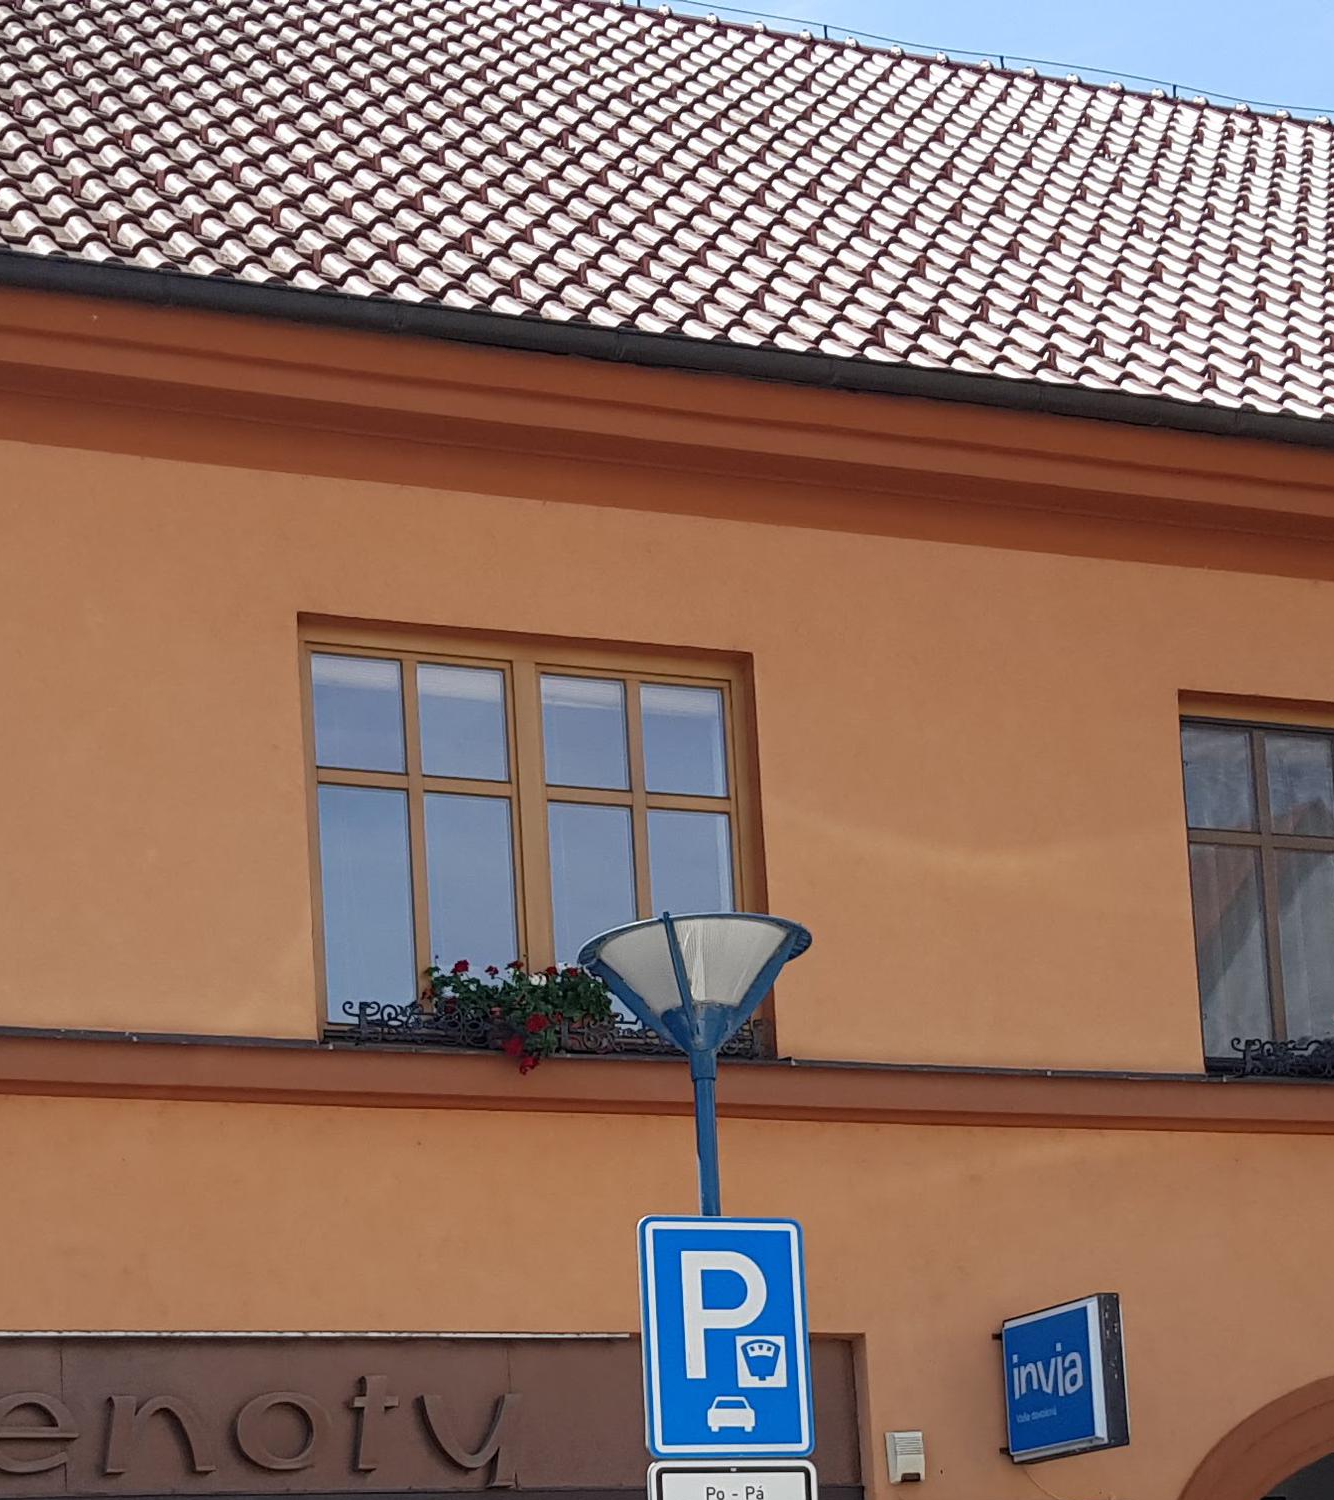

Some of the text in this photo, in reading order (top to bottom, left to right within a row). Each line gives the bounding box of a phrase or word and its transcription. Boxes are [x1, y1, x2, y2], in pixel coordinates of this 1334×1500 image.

[680, 1250, 768, 1380] P
[1012, 1342, 1084, 1401] invia
[745, 1485, 765, 1500] Pá
